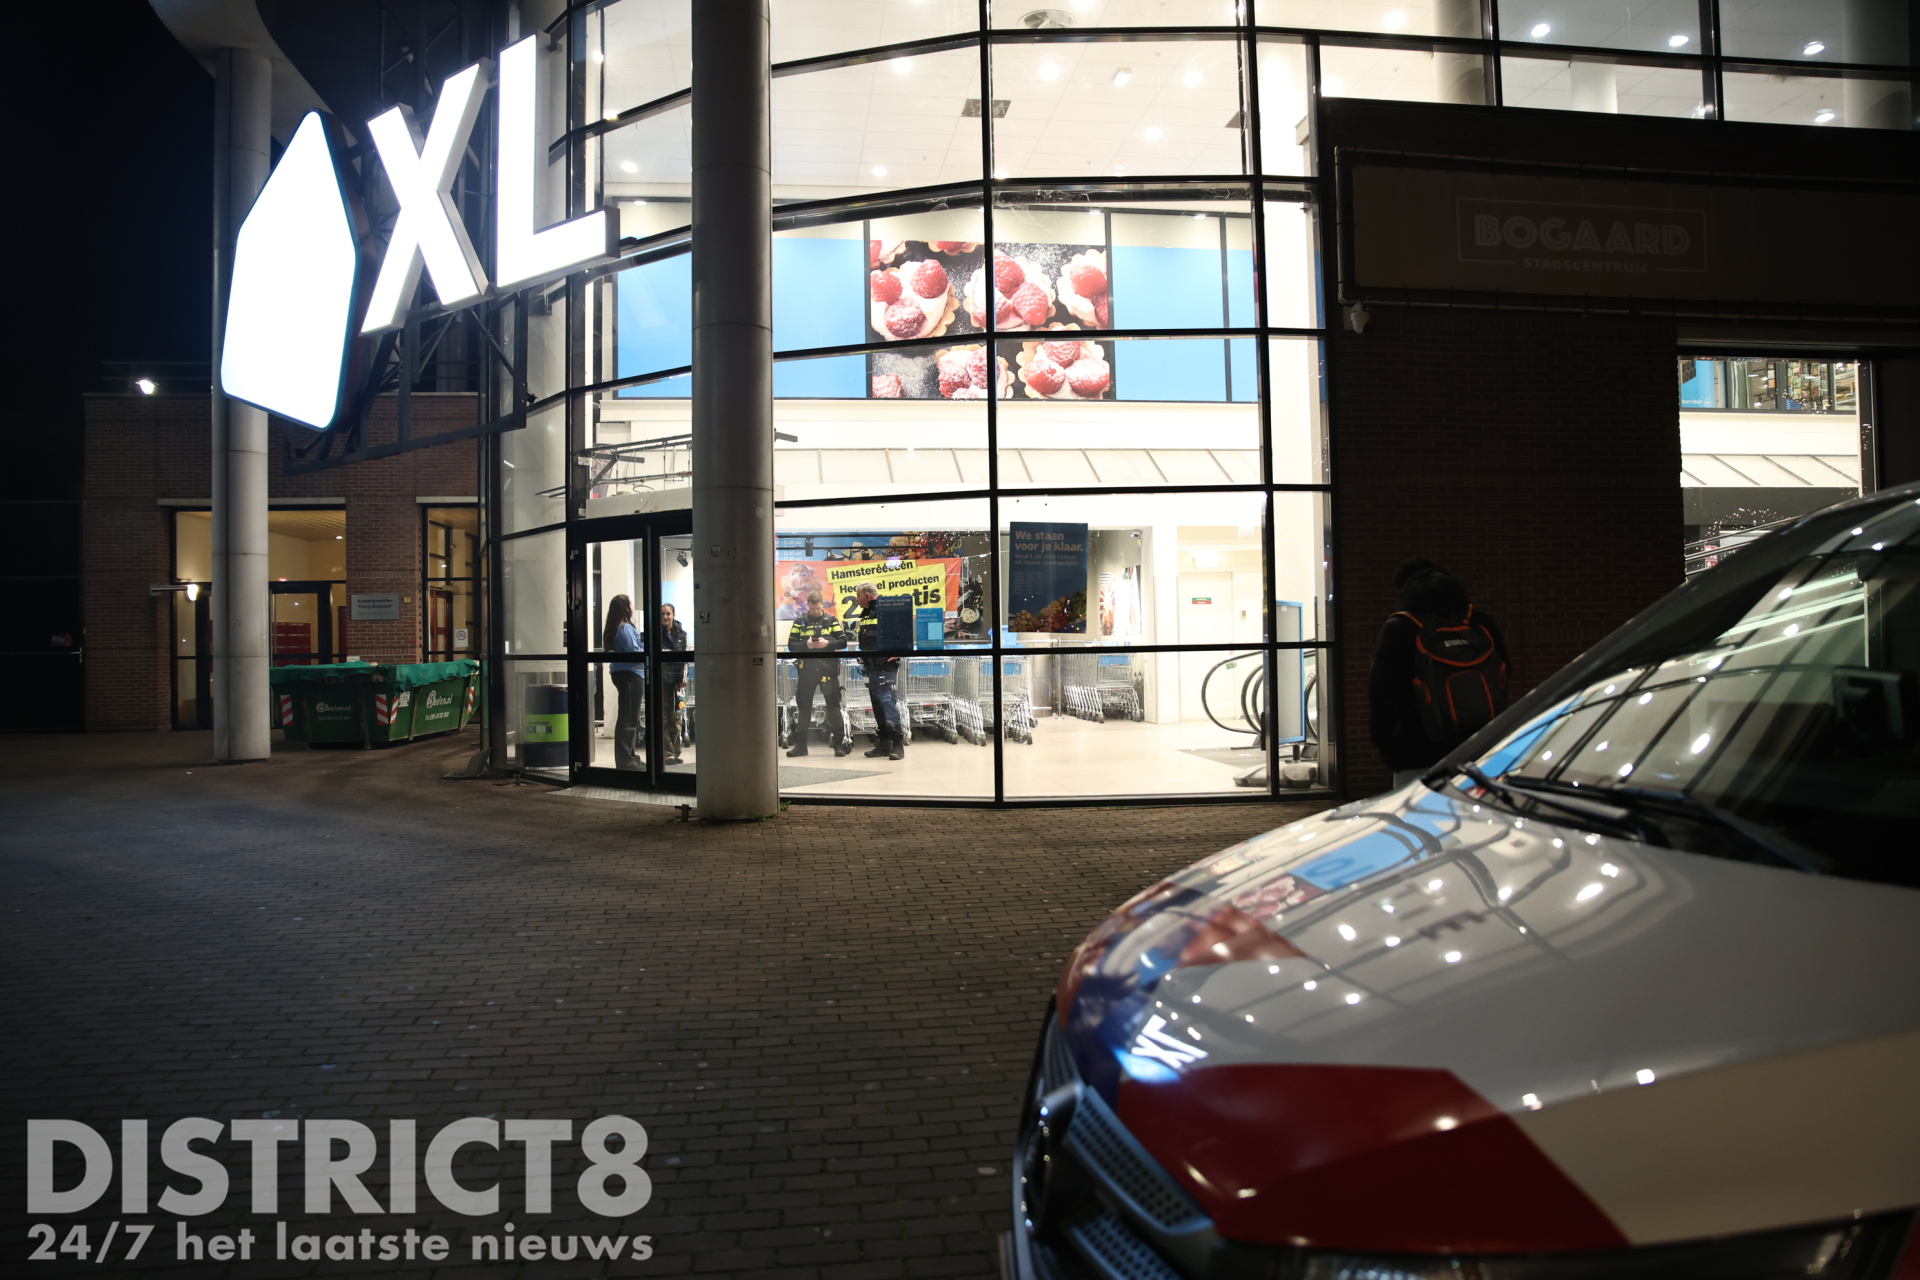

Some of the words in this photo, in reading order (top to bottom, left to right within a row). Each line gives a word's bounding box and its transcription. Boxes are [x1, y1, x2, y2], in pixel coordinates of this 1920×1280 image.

[361, 33, 613, 336] XL
[1473, 214, 1691, 257] BOGAARD
[1522, 257, 1648, 274] STADSCENTRUM
[1014, 530, 1032, 540] We
[1034, 531, 1065, 540] staan
[1014, 542, 1040, 551] voor
[1040, 541, 1052, 553] je
[1054, 541, 1084, 552] klaar.
[840, 585, 858, 594] Hee
[888, 575, 939, 591] producten
